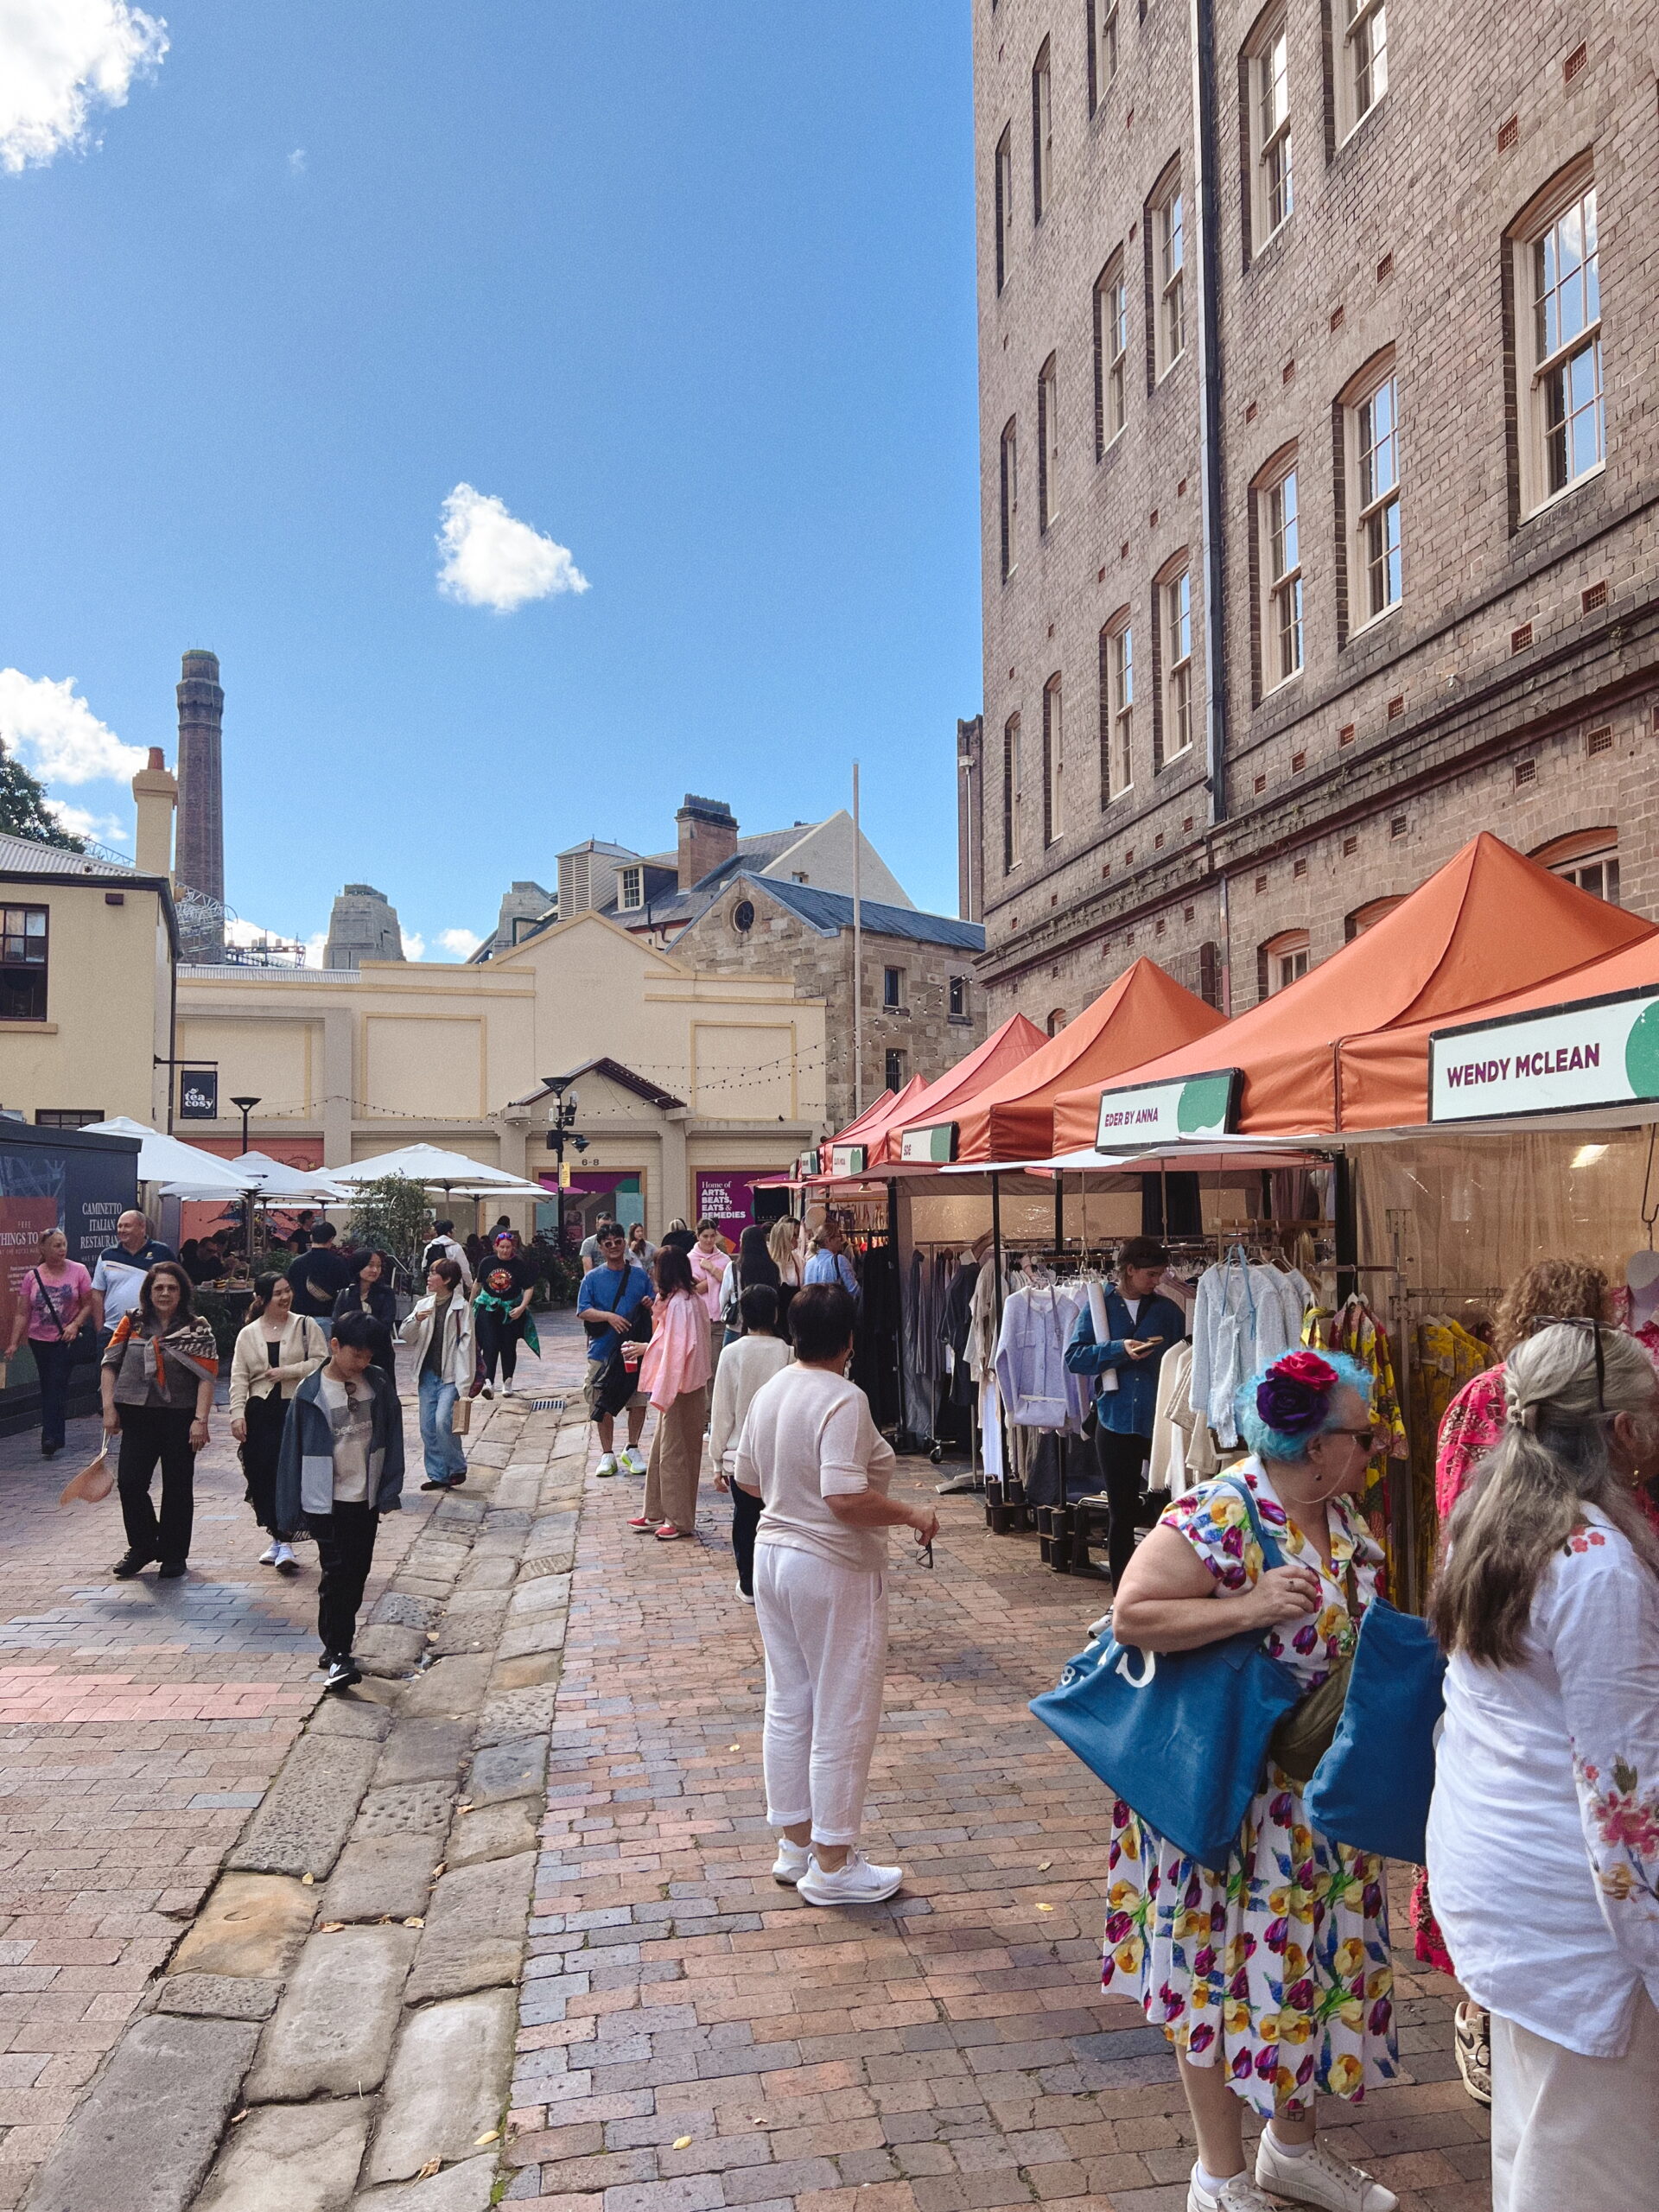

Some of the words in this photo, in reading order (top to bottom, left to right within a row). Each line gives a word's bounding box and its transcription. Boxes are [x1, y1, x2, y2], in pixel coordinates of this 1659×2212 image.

[1446, 1058, 1511, 1088] WENDY
[1516, 1042, 1600, 1078] MCLEAN
[184, 1092, 206, 1101] tea
[184, 1098, 213, 1109] cosy
[1104, 1112, 1123, 1128] EDER
[1124, 1110, 1135, 1125] BY
[1135, 1107, 1159, 1124] ANNA
[724, 1180, 732, 1189] of
[702, 1196, 733, 1205] BEATS,
[82, 1202, 123, 1215] CAMINETTO
[89, 1218, 117, 1232] ITALIAN
[27, 1231, 39, 1244] TO
